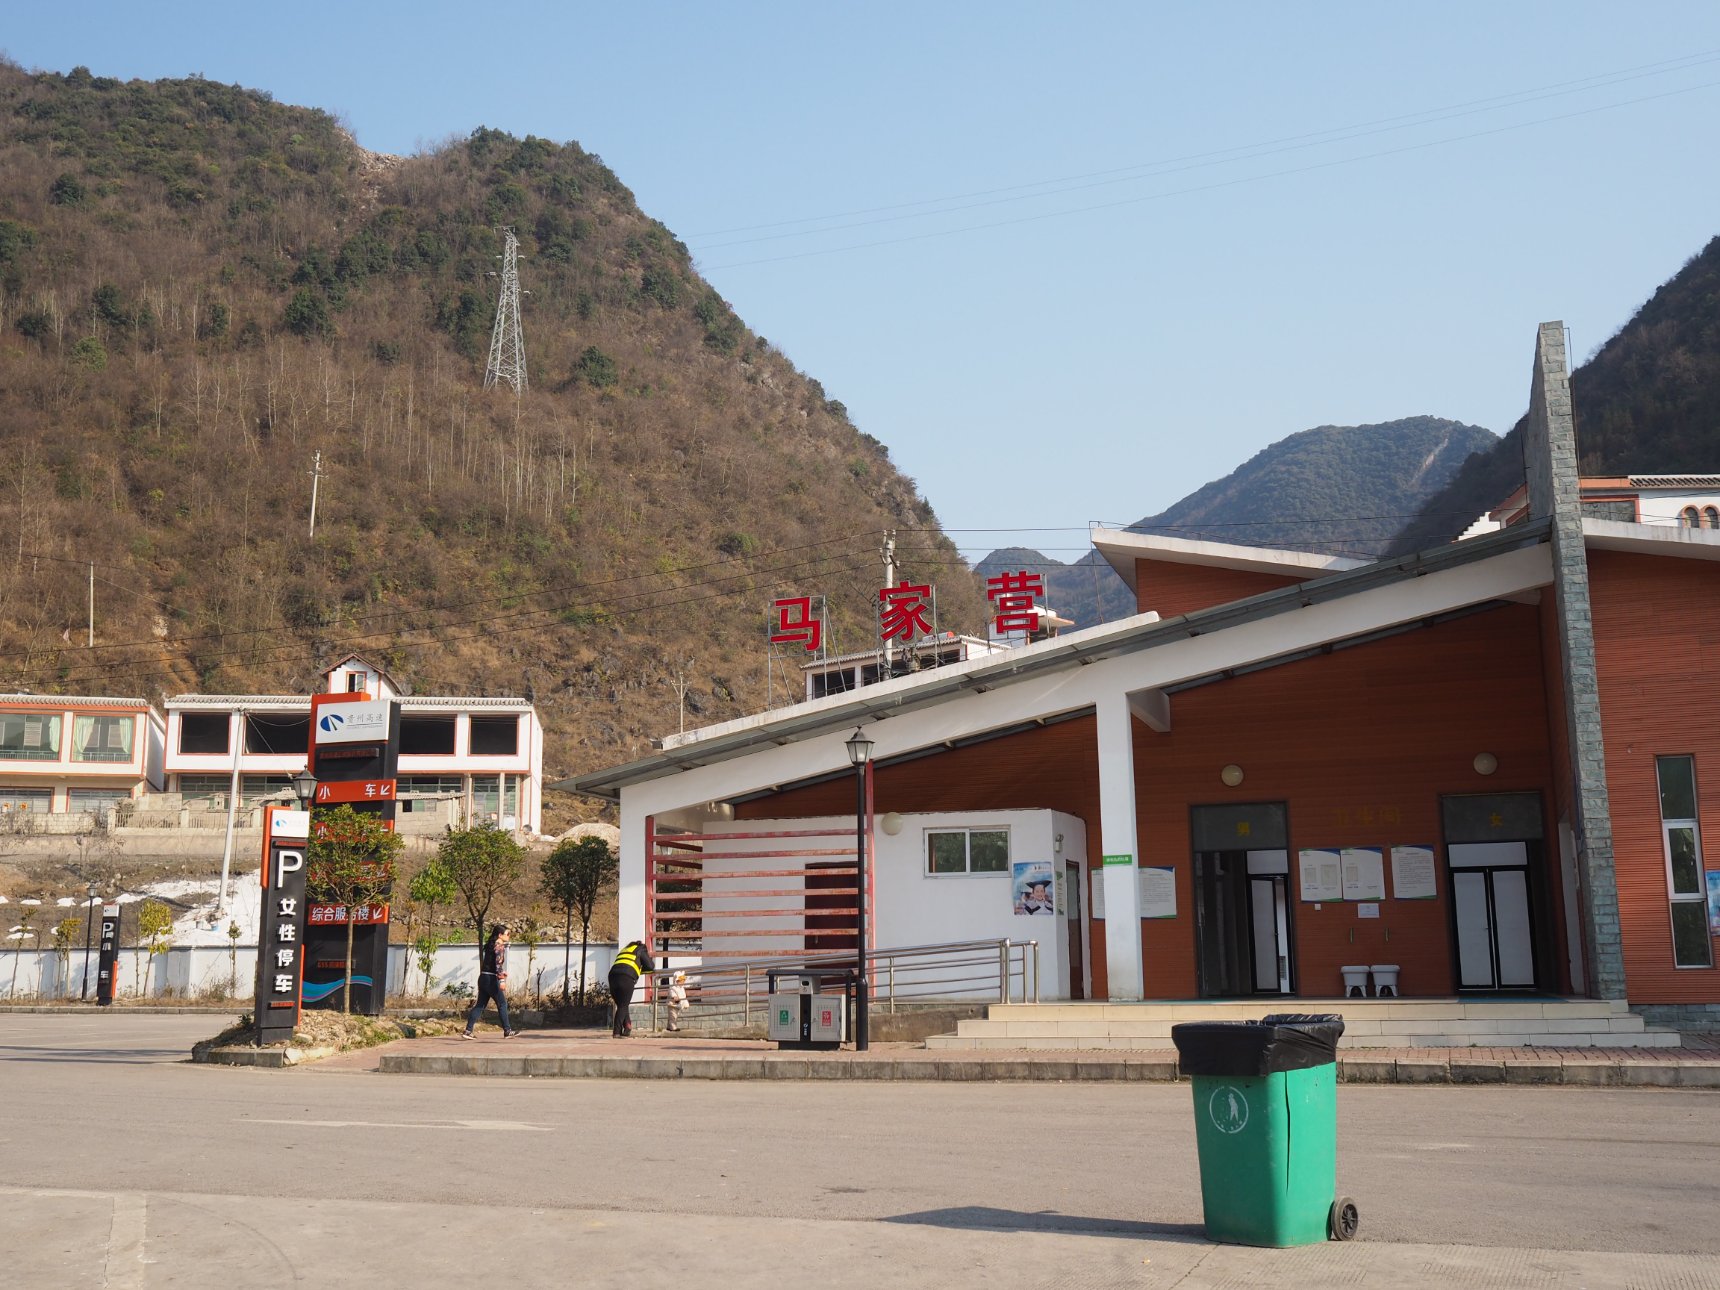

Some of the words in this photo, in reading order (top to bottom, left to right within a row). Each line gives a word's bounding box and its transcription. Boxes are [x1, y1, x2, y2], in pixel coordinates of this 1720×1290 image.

[771, 571, 1043, 650] 马家营
[277, 850, 303, 888] P
[275, 897, 297, 993] 女性停车
